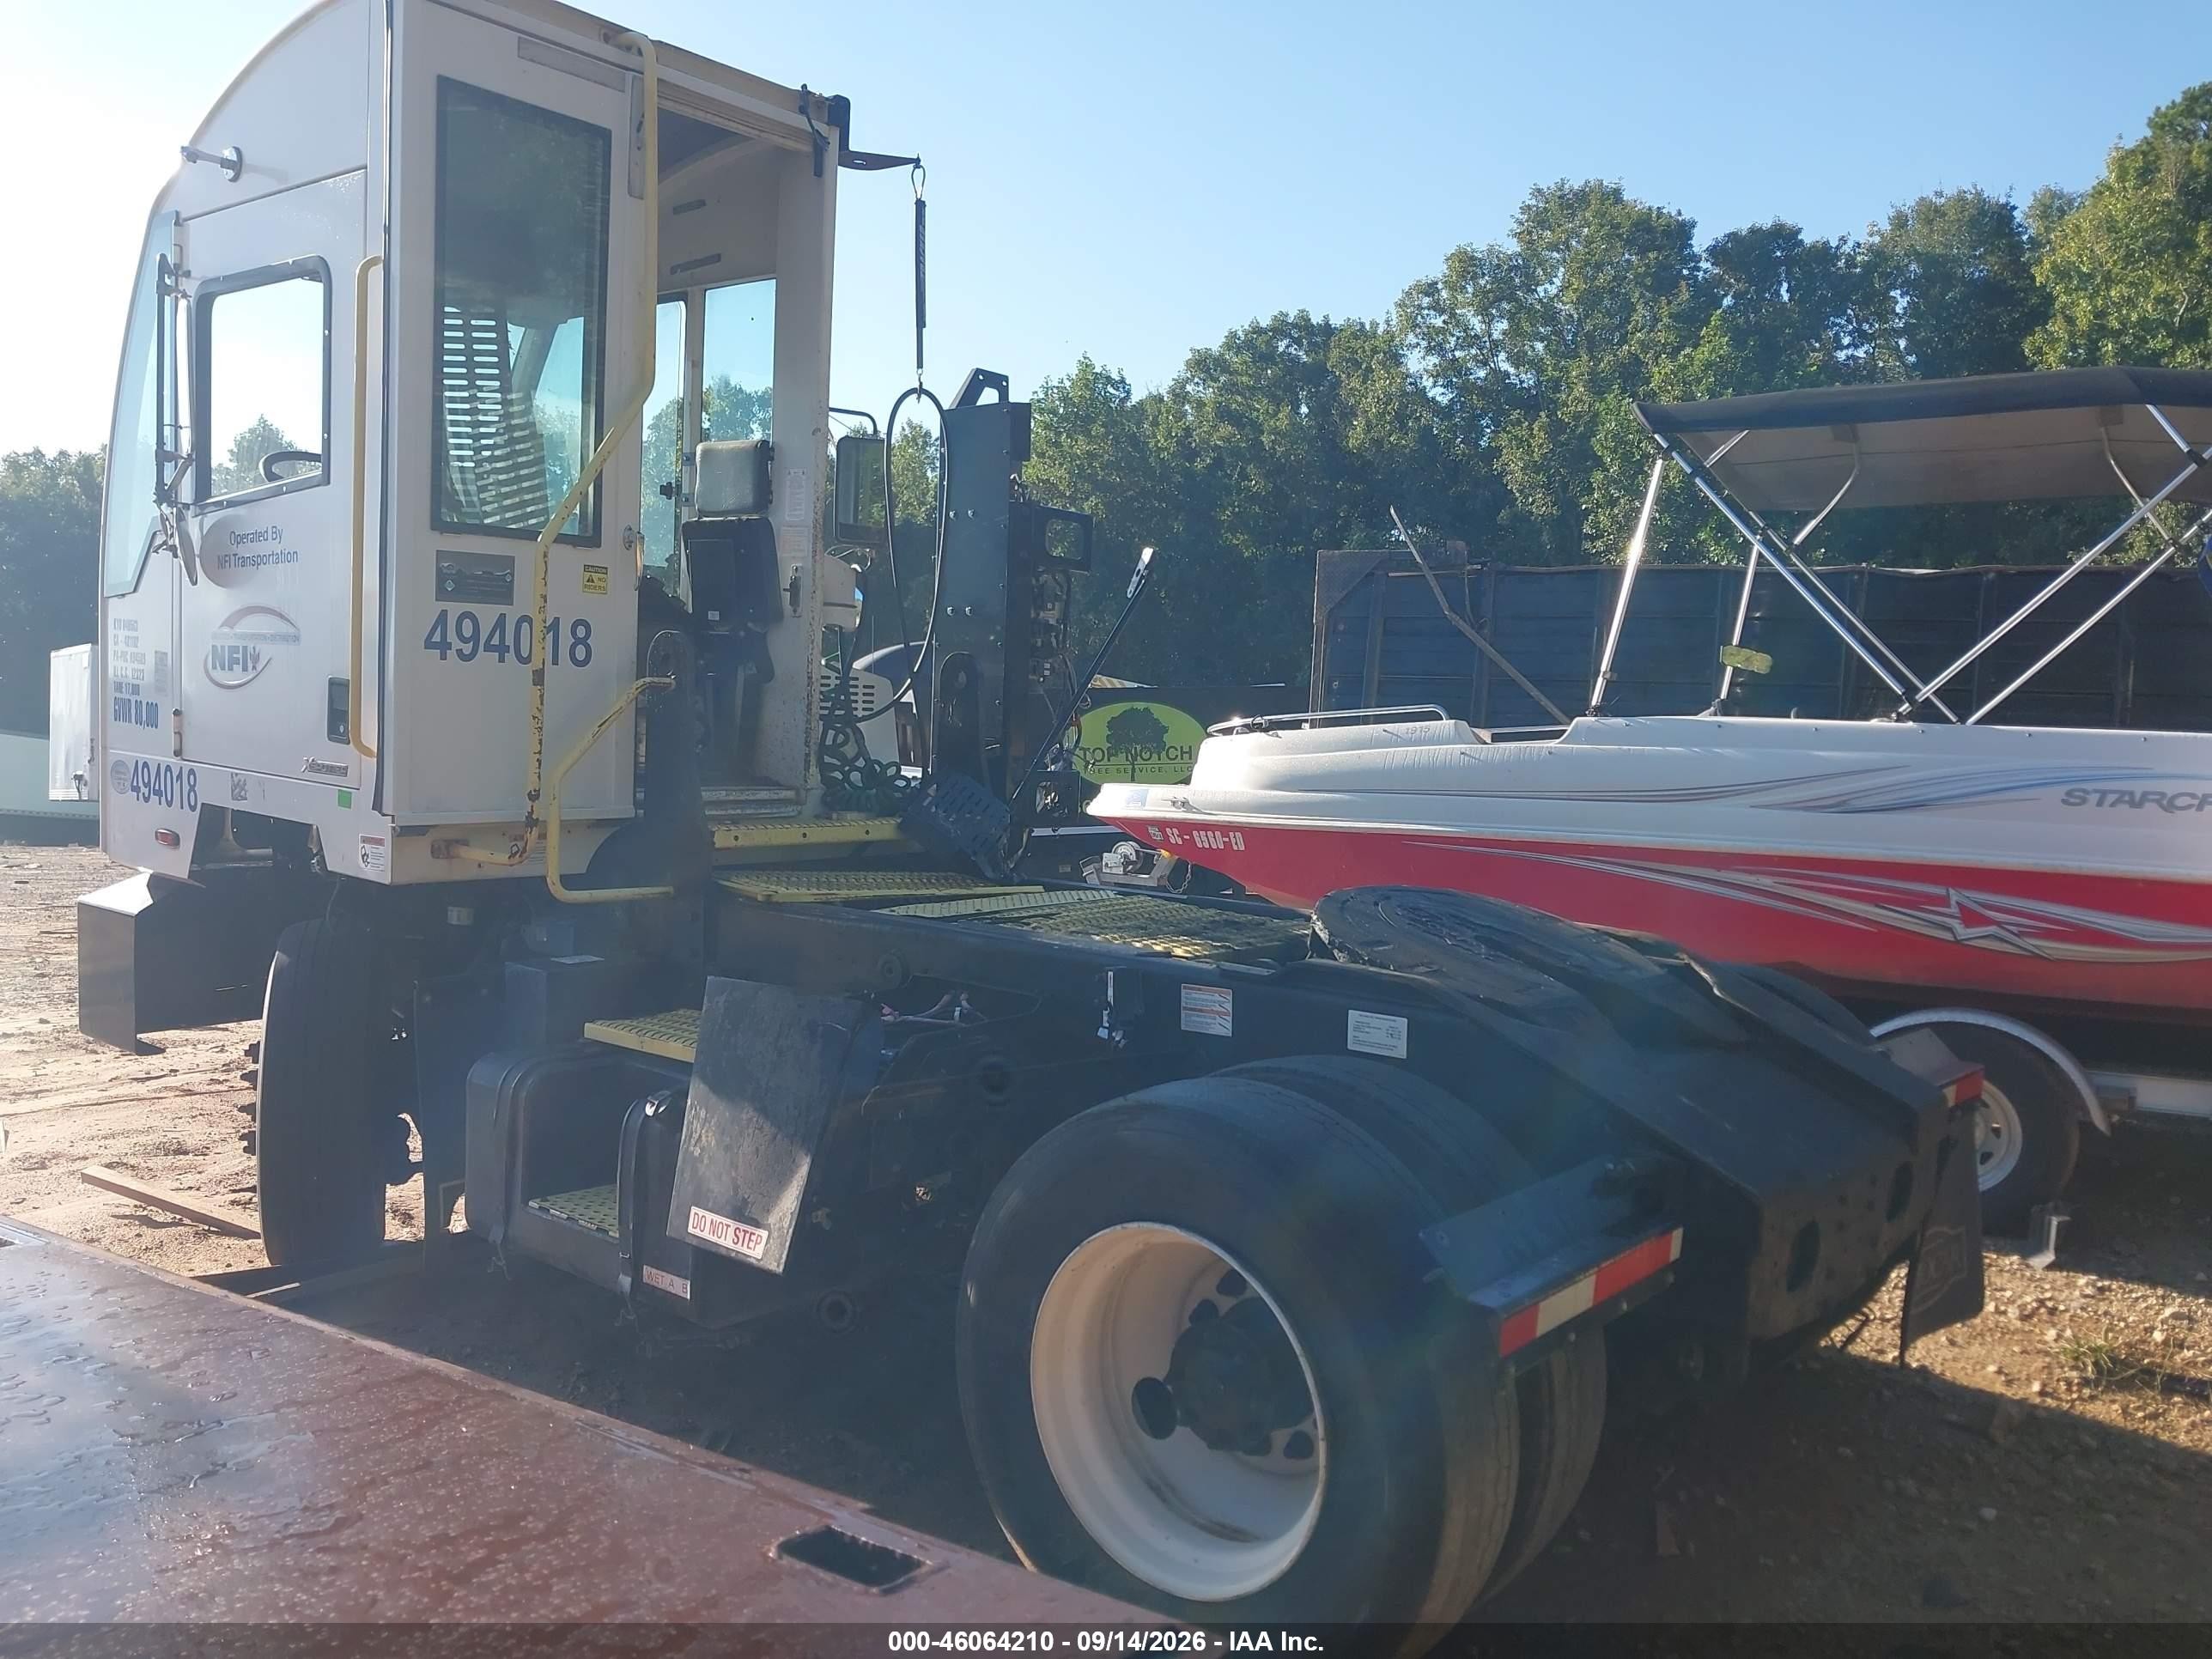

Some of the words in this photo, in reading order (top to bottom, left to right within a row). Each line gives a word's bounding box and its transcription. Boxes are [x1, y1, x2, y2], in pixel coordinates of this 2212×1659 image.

[229, 526, 268, 548] Operated
[271, 526, 283, 544] By
[217, 554, 231, 569] NFI
[233, 549, 298, 570] Transportation
[424, 610, 592, 668] 494018
[211, 645, 248, 672] NFI
[114, 696, 131, 724] GVWR
[135, 699, 158, 730] 80,000
[1125, 744, 1192, 763] NOTCH
[131, 759, 198, 812] 494018
[1165, 827, 1183, 845] SC
[692, 1212, 707, 1233] DO
[708, 1218, 731, 1242] NOT
[732, 1226, 763, 1252] STEP
